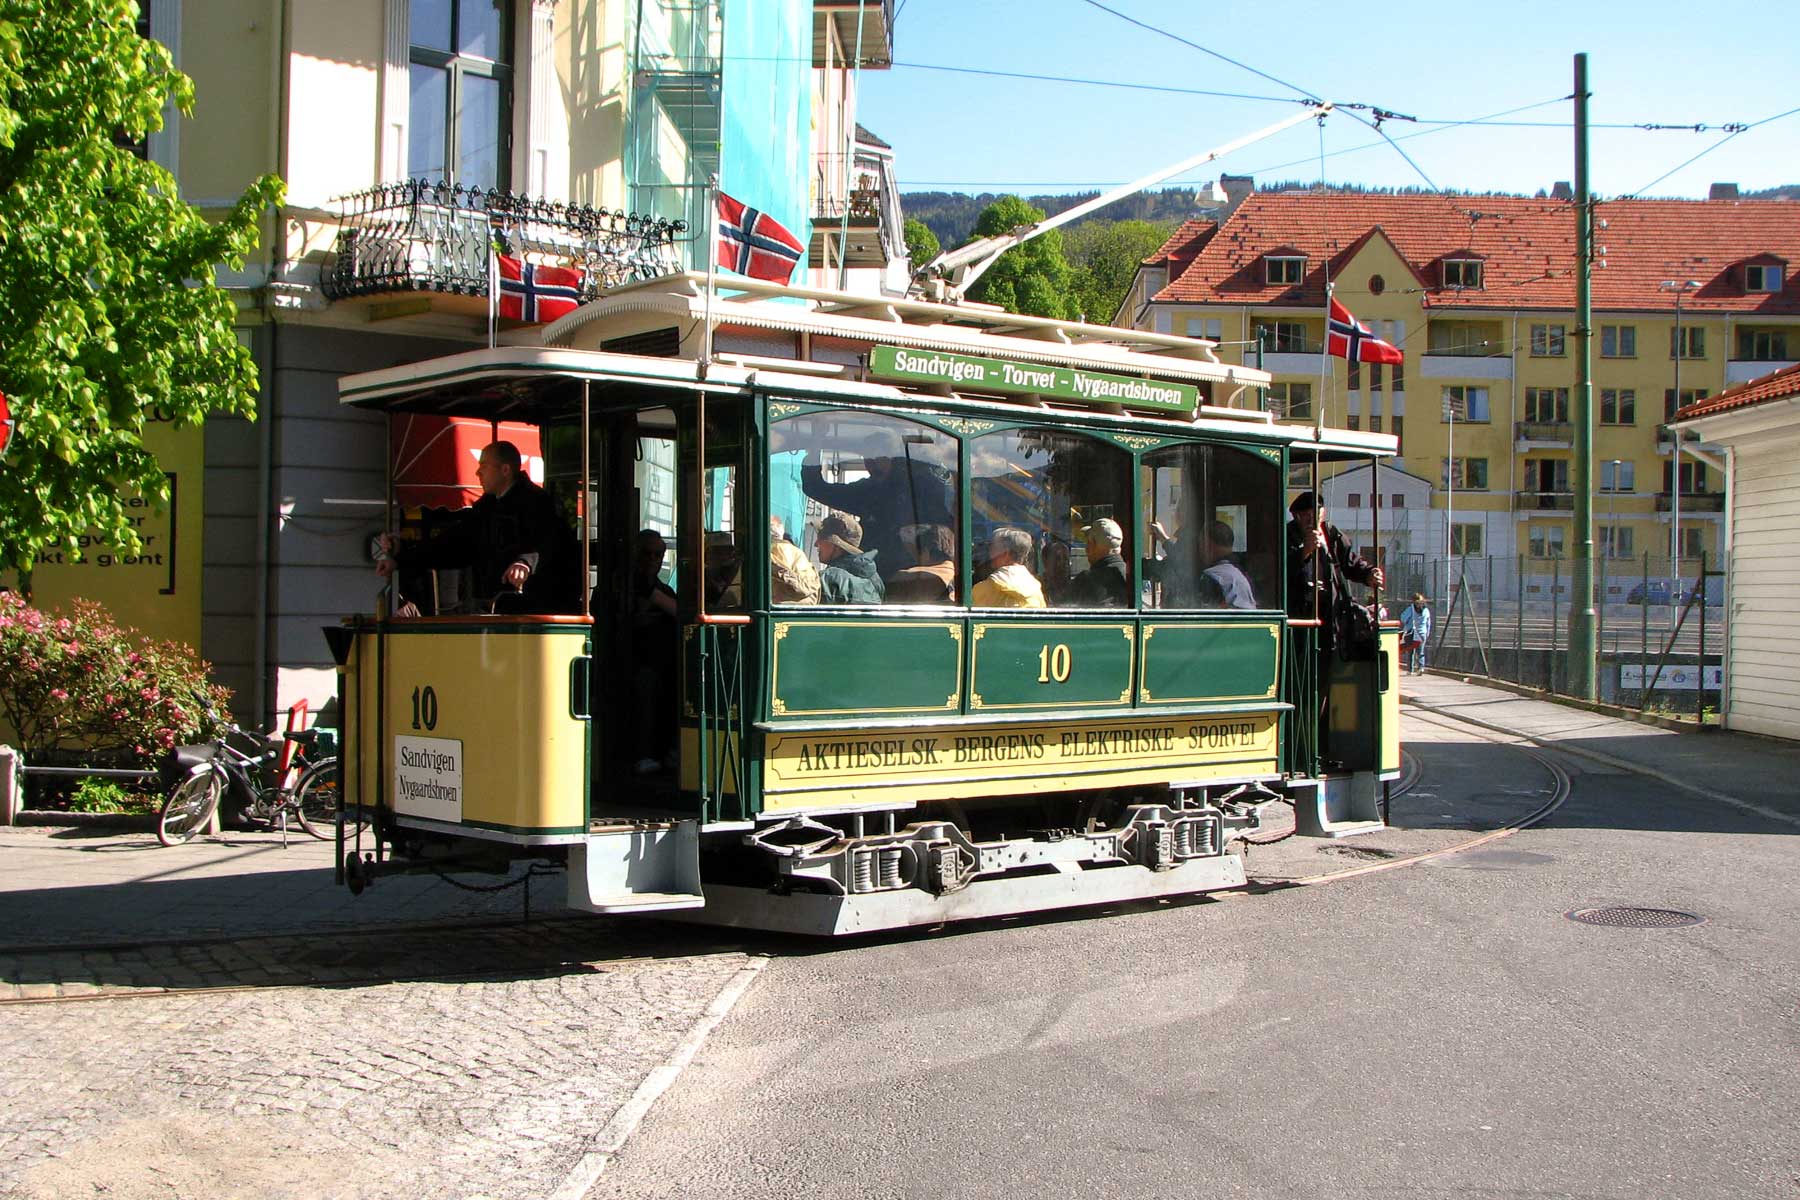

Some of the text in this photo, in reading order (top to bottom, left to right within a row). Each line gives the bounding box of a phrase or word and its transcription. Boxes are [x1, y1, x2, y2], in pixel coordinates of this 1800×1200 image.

[894, 351, 984, 382] Sandvigen
[1003, 364, 1056, 389] Torvet
[1072, 373, 1182, 405] Nygaardsbroen
[1037, 643, 1072, 684] 10
[411, 685, 438, 731] 10
[401, 746, 456, 775] Sandvigen
[953, 733, 1045, 763] BERGENS
[1060, 726, 1175, 758] ELEKTRISKE
[1188, 722, 1256, 750] SPORVEI
[399, 774, 458, 802] Nygaardsbroen
